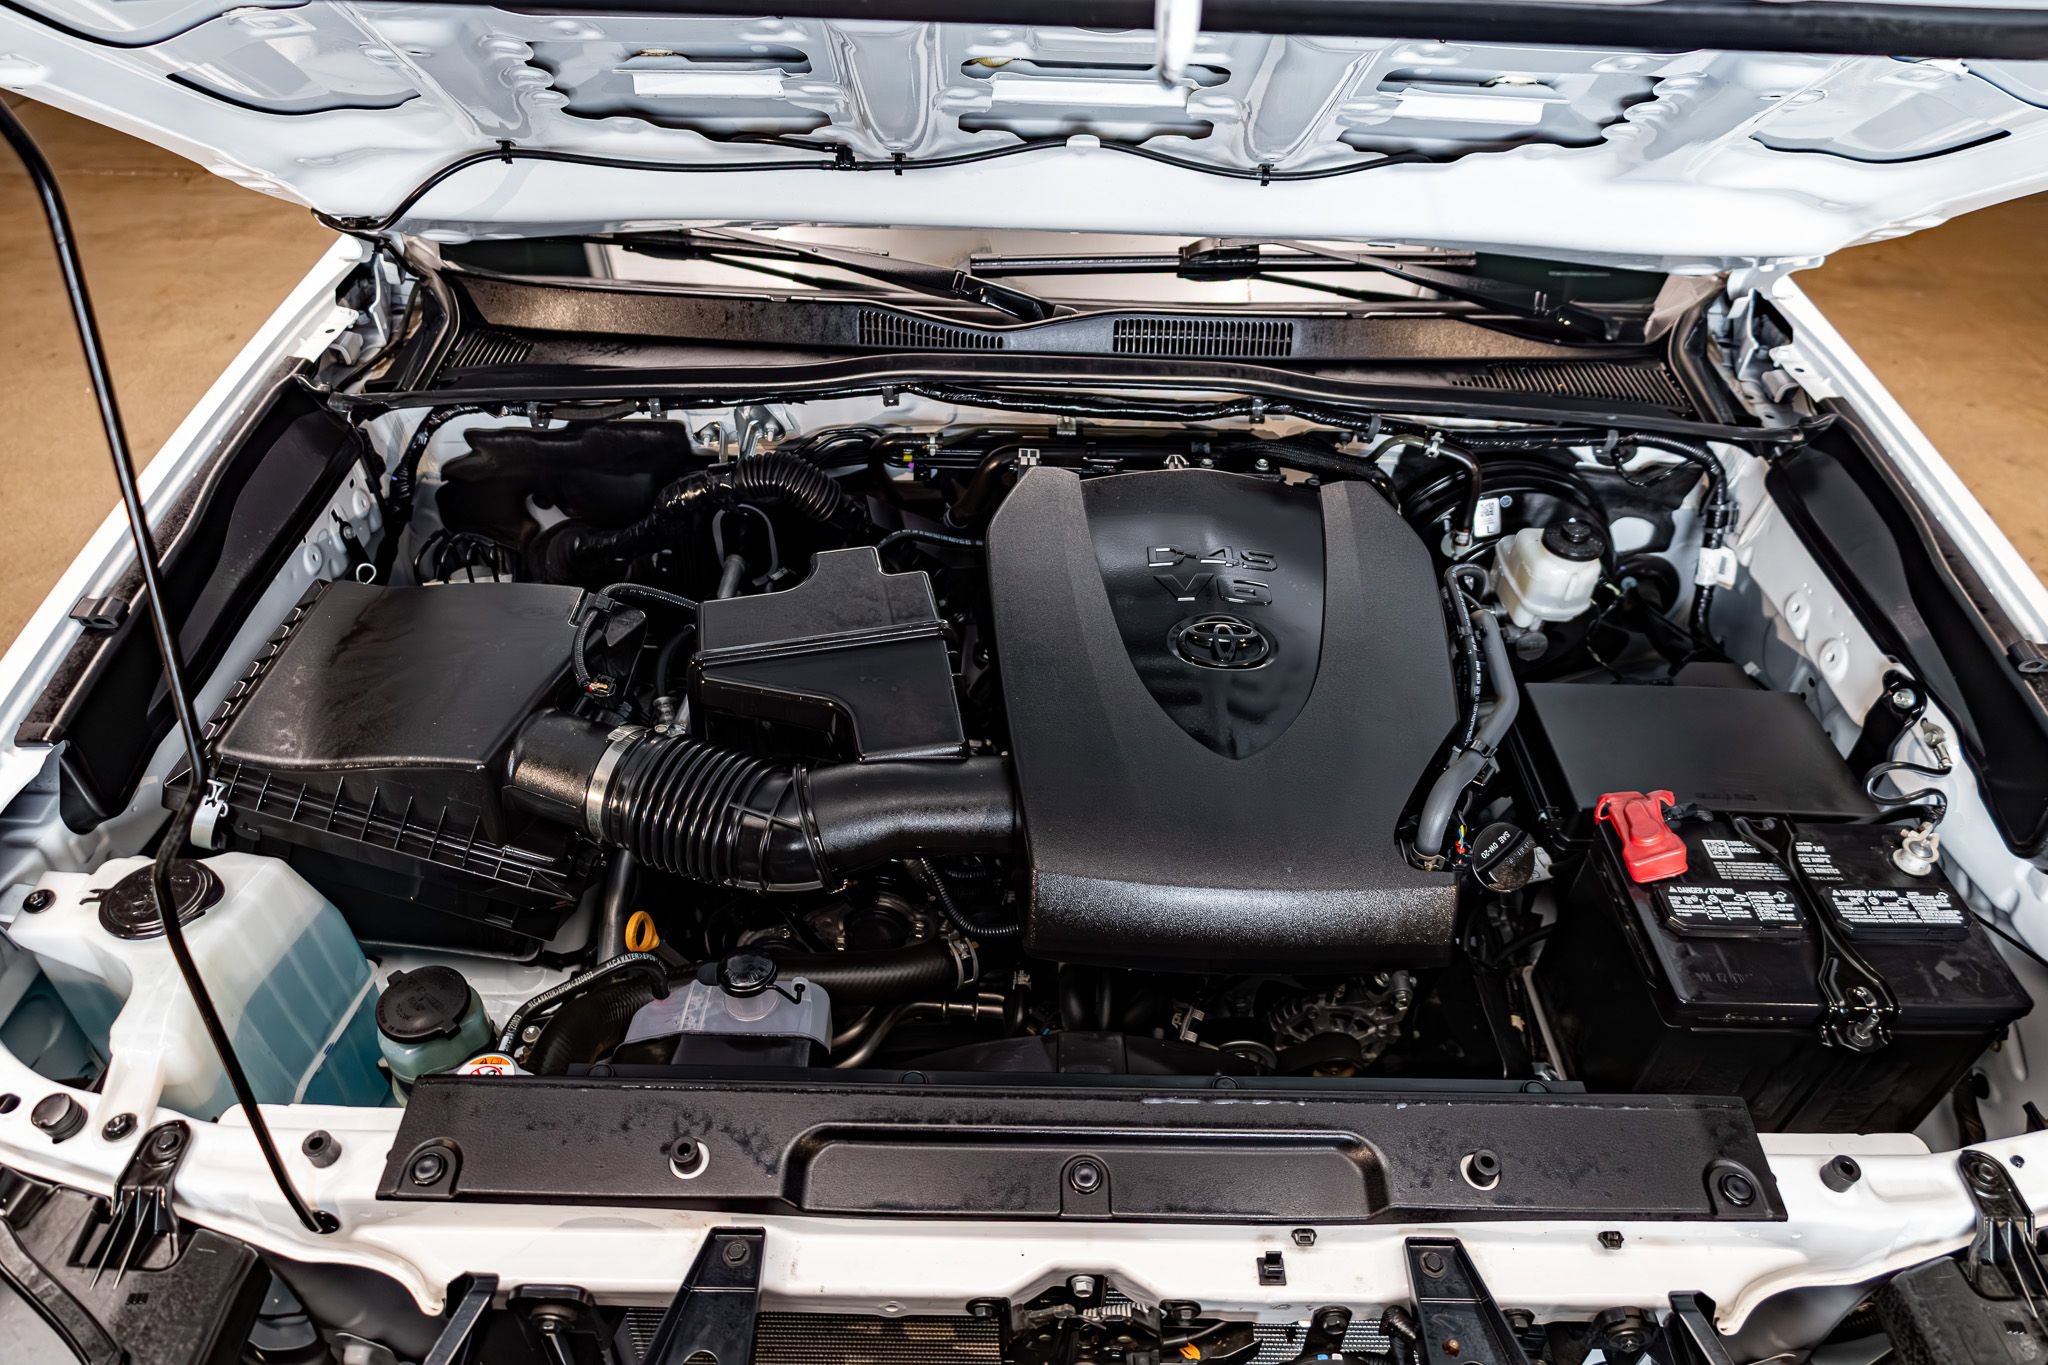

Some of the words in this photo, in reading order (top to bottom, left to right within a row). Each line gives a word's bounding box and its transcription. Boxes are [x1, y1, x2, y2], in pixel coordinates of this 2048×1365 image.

[1146, 545, 1278, 572] D-4S
[1153, 572, 1273, 606] V6
[1497, 830, 1511, 844] SAE
[1480, 842, 1499, 859] 0W-20
